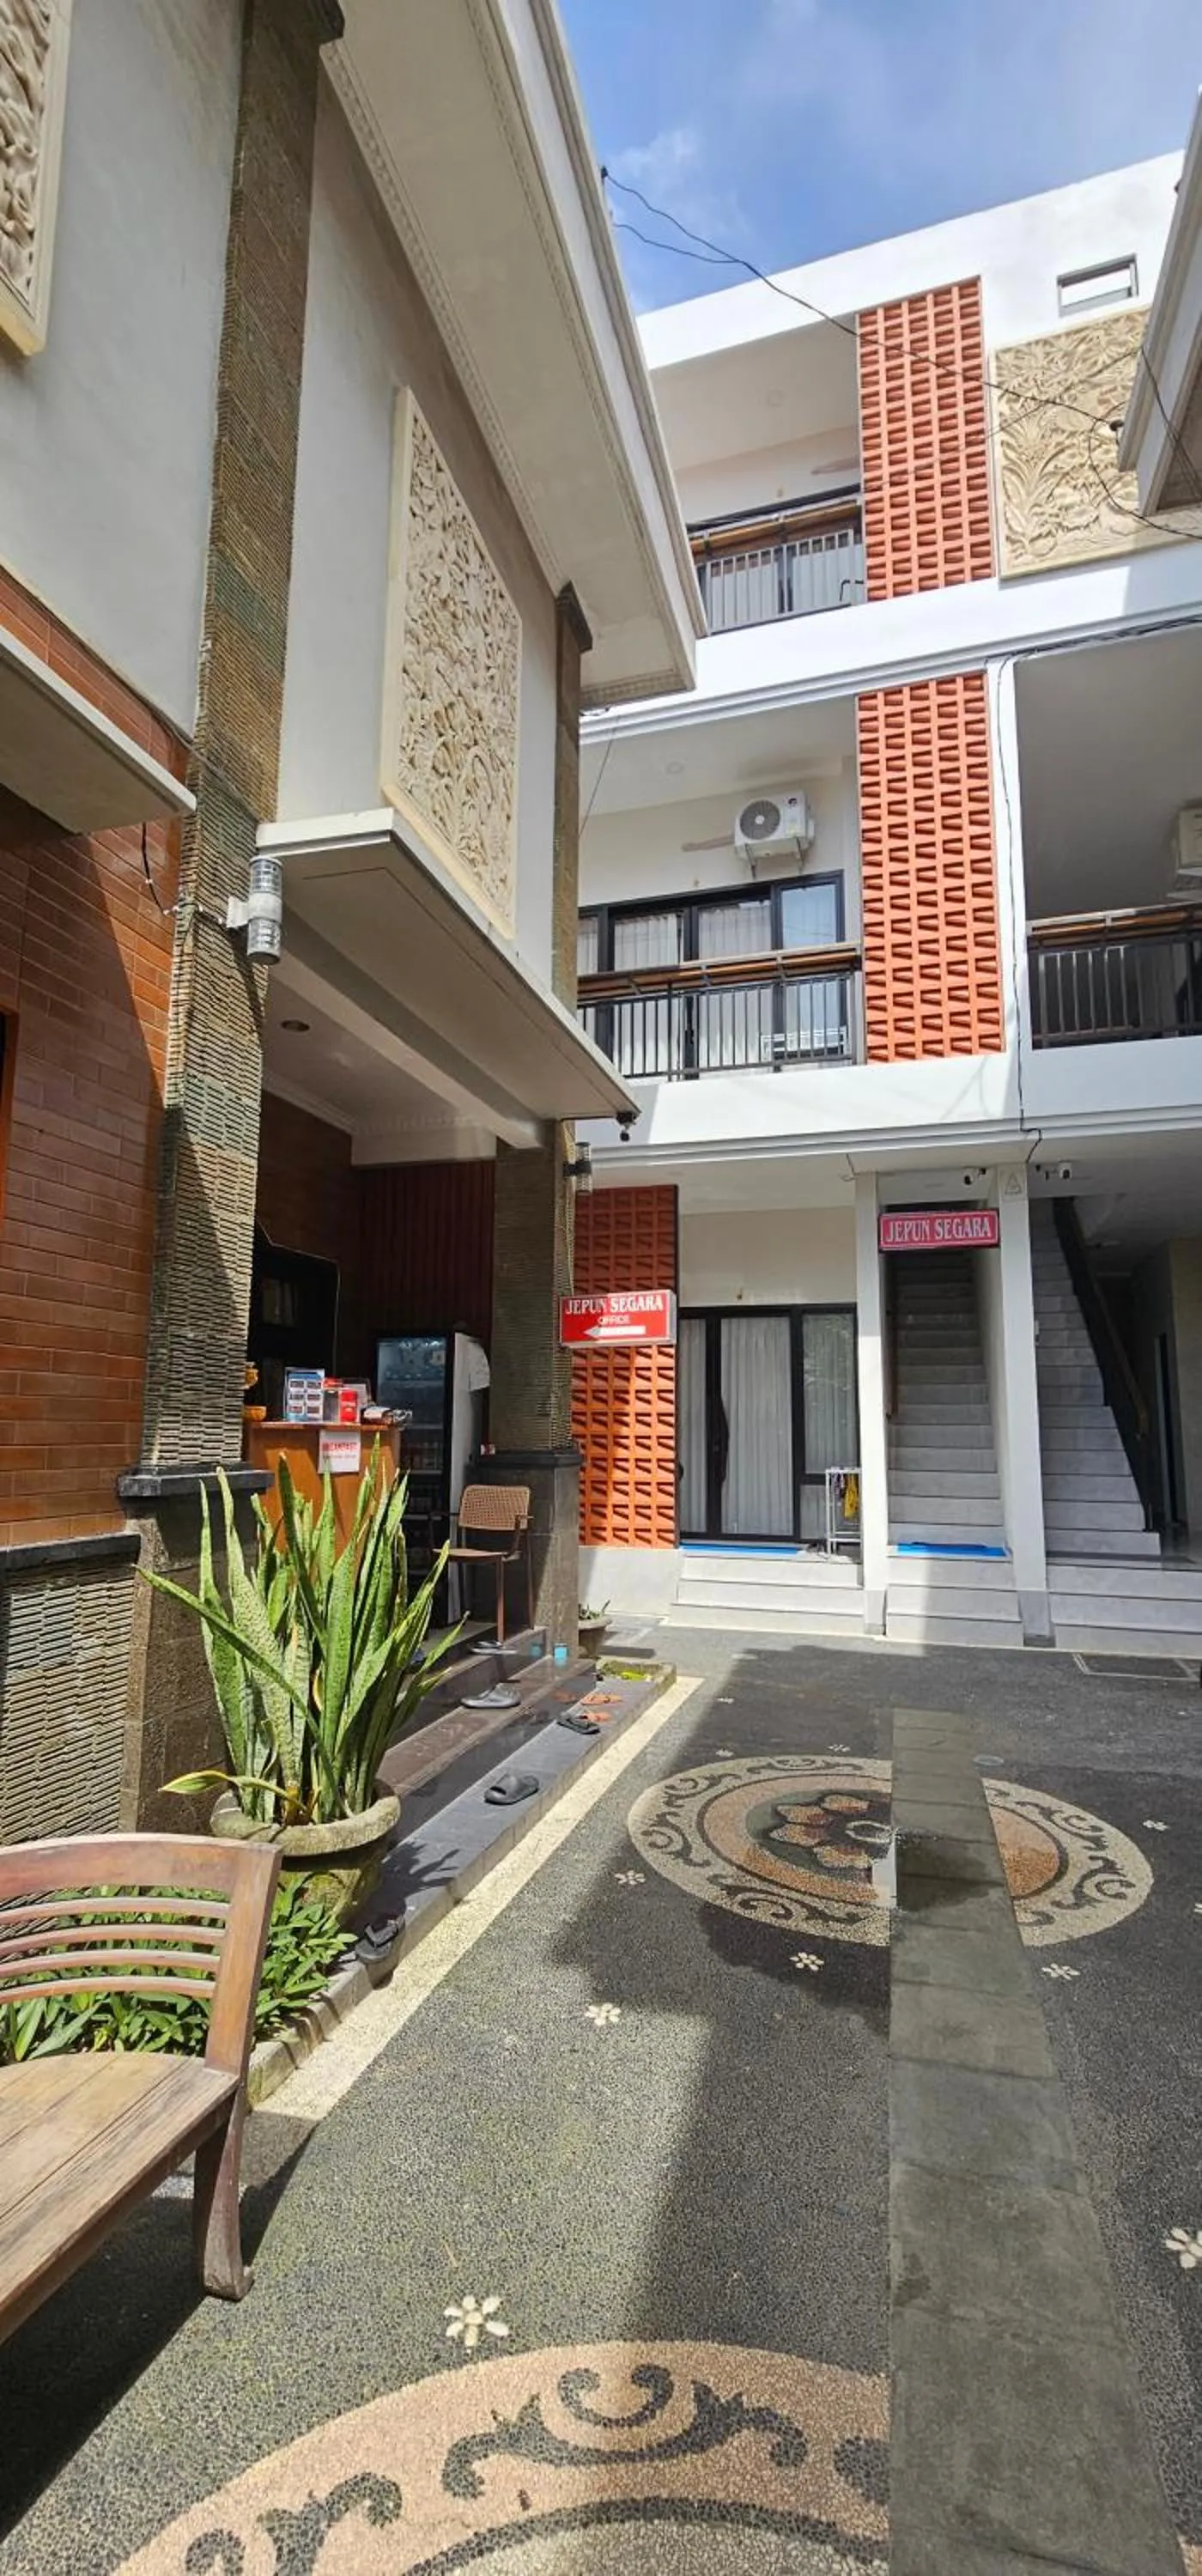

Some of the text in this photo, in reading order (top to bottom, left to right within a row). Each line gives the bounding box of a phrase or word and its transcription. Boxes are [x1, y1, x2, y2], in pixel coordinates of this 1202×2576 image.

[885, 1216, 992, 1242] JEPUN SEGARA
[566, 1294, 664, 1315] JEPUN SEGARA
